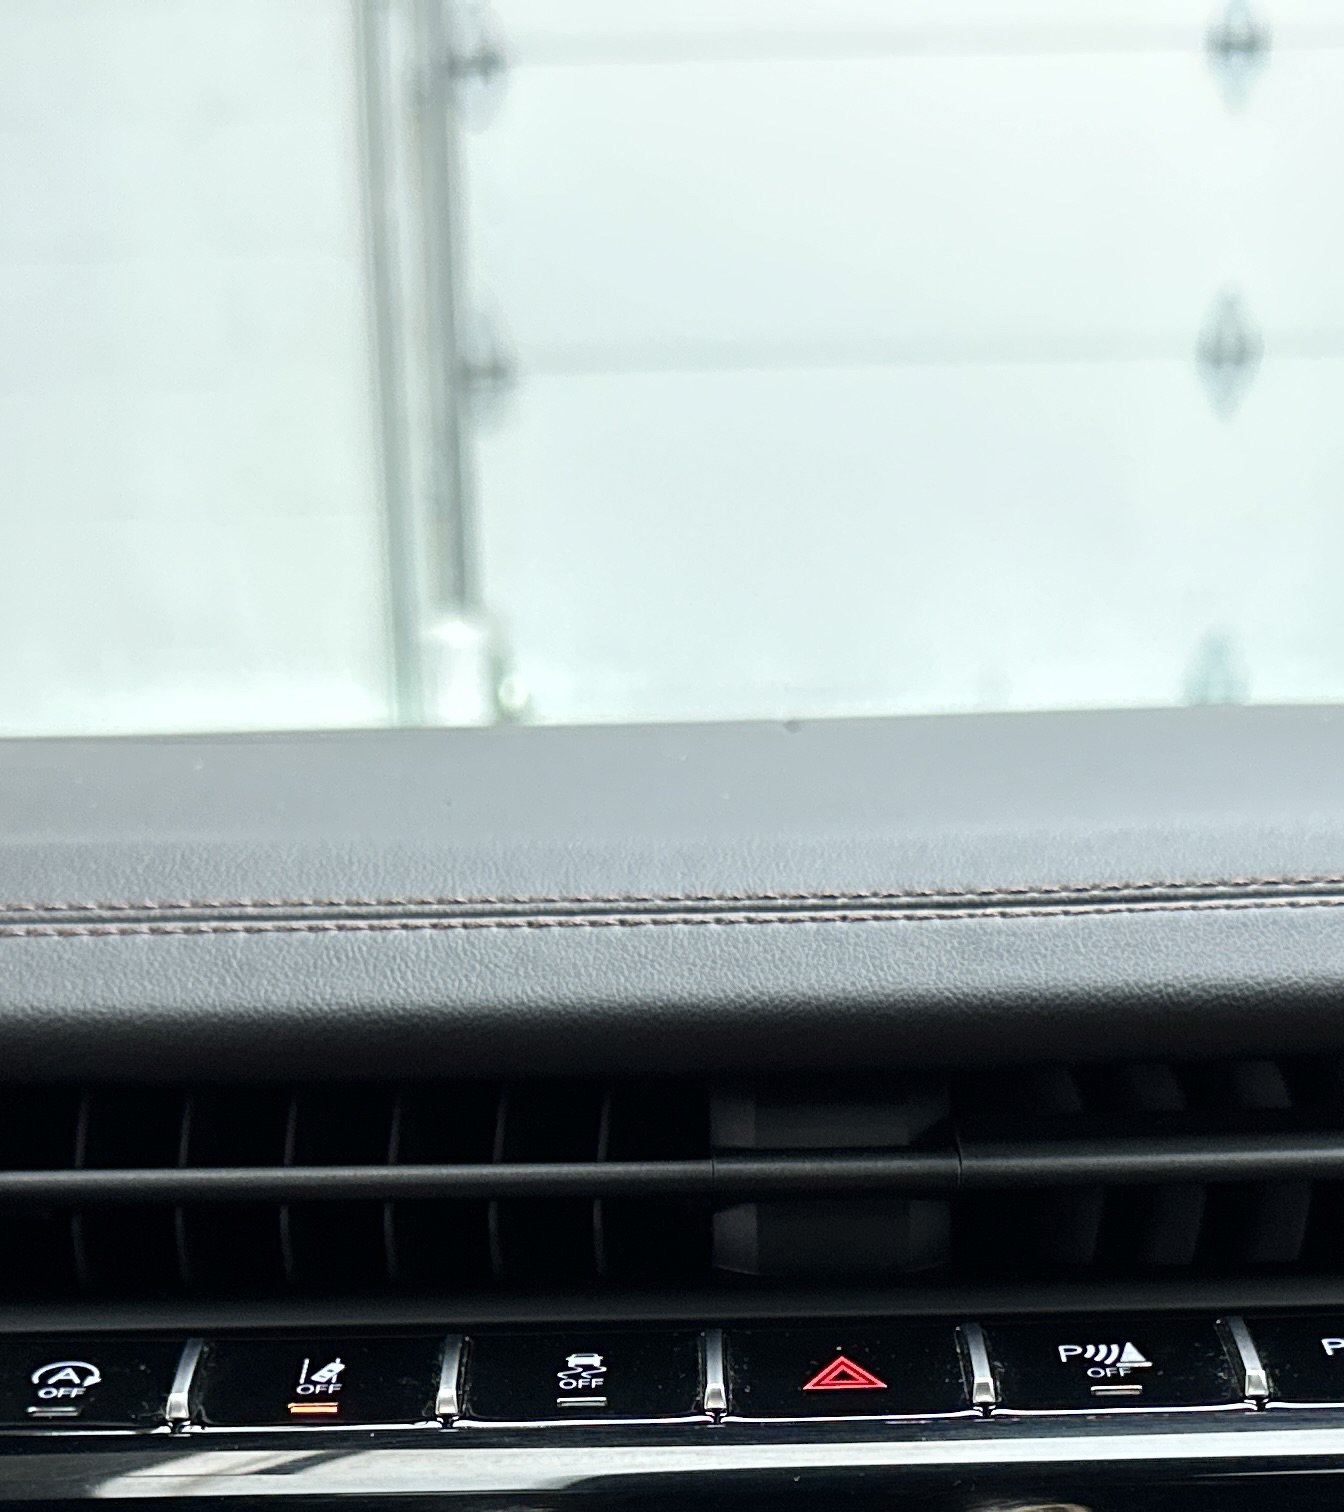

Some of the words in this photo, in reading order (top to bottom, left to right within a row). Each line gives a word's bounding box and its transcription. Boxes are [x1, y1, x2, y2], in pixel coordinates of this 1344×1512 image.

[1086, 1364, 1135, 1378] OFF
[296, 1384, 342, 1395] OFF
[558, 1378, 605, 1390] OFF
[37, 1387, 87, 1399] OFF
